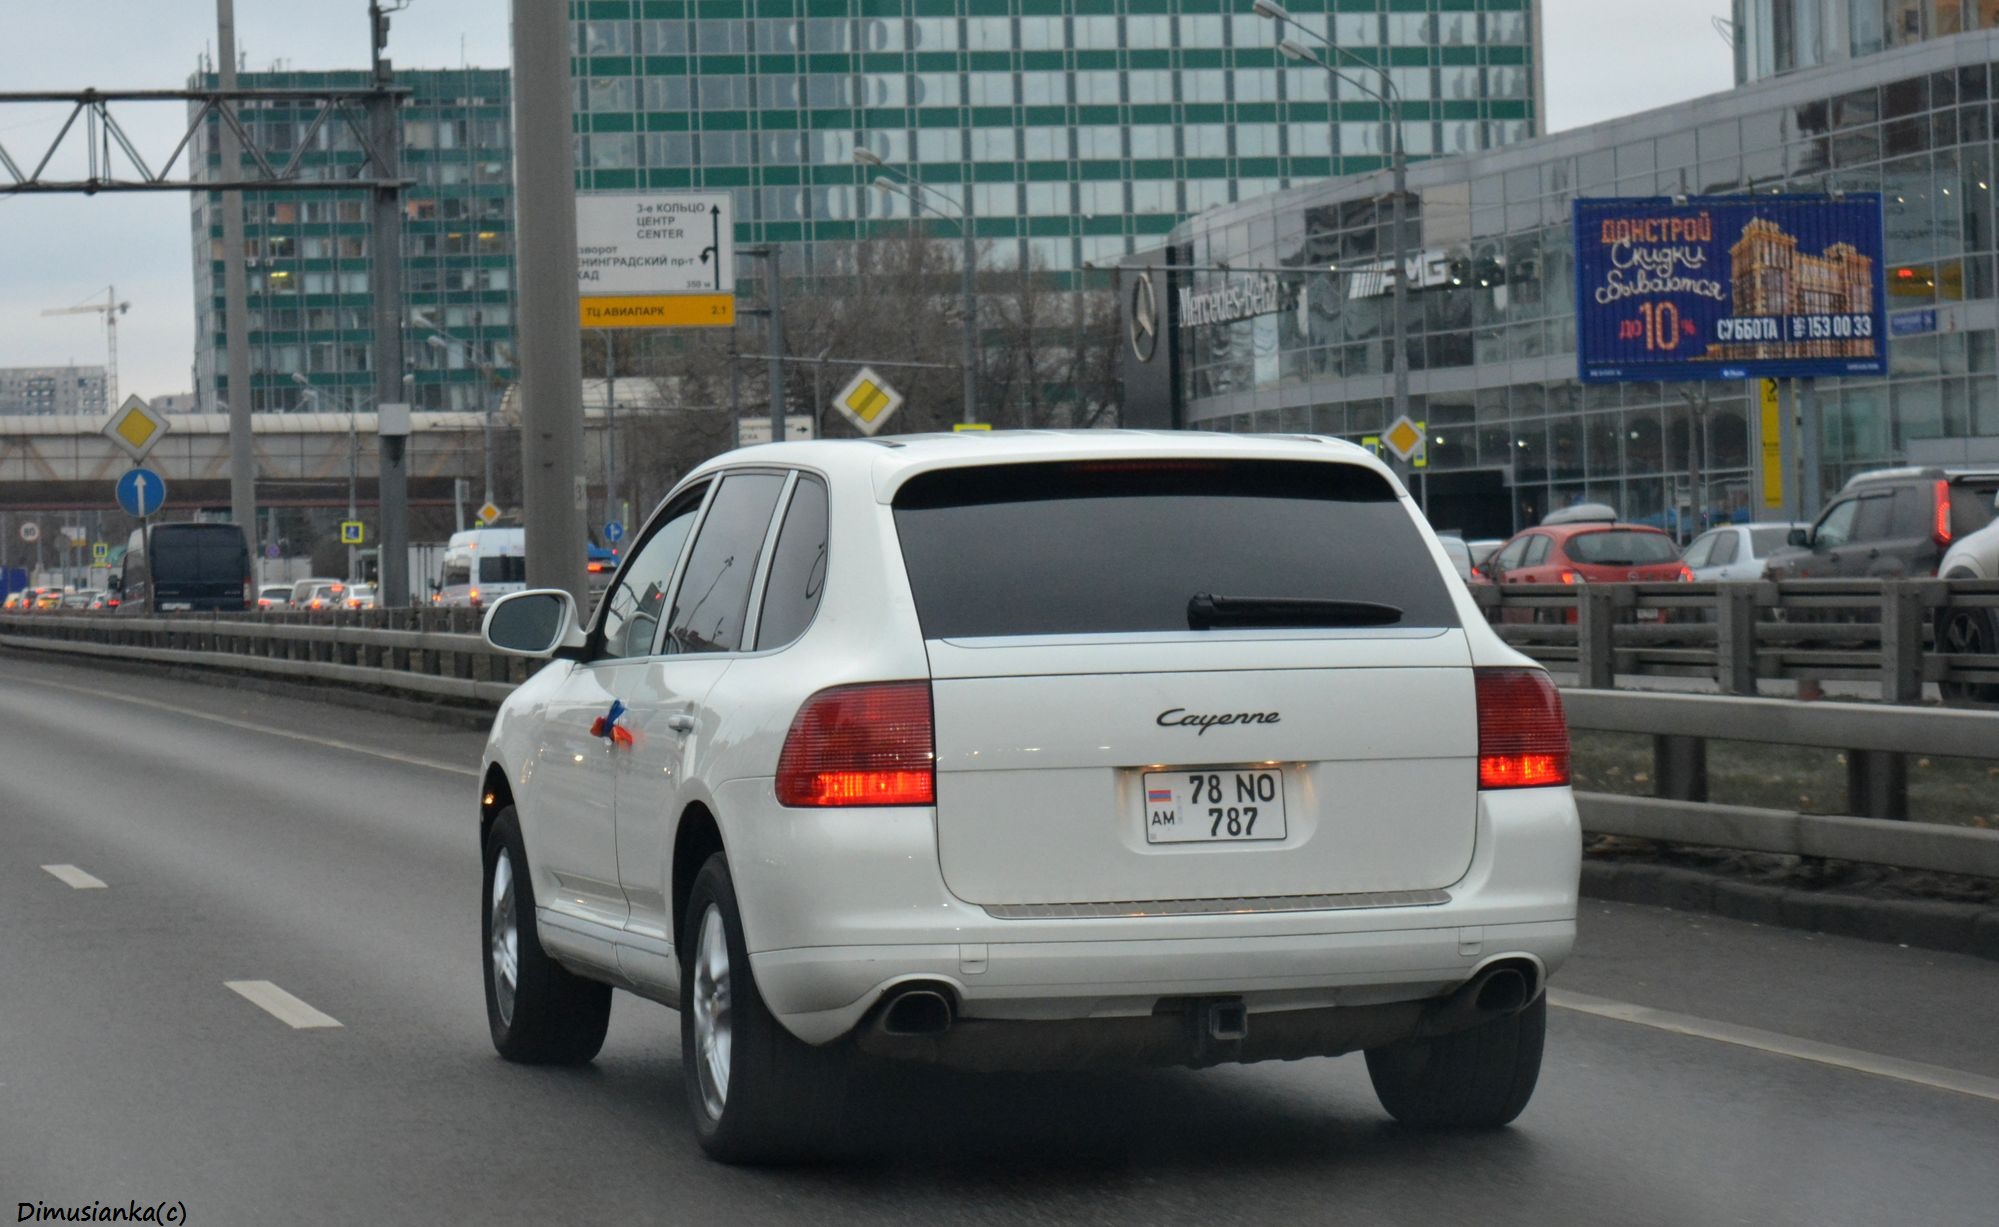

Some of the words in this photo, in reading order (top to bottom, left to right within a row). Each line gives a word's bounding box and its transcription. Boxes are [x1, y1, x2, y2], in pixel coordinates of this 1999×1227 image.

[656, 203, 705, 214] КОЛЬЦО
[637, 217, 675, 228] ЦЕНТР
[637, 229, 684, 239] CENTER
[1601, 211, 1712, 244] ДОНСТРОЙ
[580, 256, 668, 268] НИНГРАДСКИЙ
[1611, 237, 1706, 278] Скидки
[577, 270, 600, 281] КАД
[586, 307, 601, 318] ТЦ
[604, 306, 664, 316] АВИАПАРК
[1179, 274, 1278, 328] Mercedes-Benz
[1717, 318, 1778, 340] СУББОТА
[1808, 316, 1831, 338] 153
[1833, 315, 1851, 337] 00
[1853, 315, 1872, 336] 33
[1156, 708, 1281, 736] Cayenne
[1189, 774, 1223, 804] 78
[1236, 773, 1275, 803] NO
[1151, 810, 1175, 826] AM
[1208, 807, 1258, 836] 787
